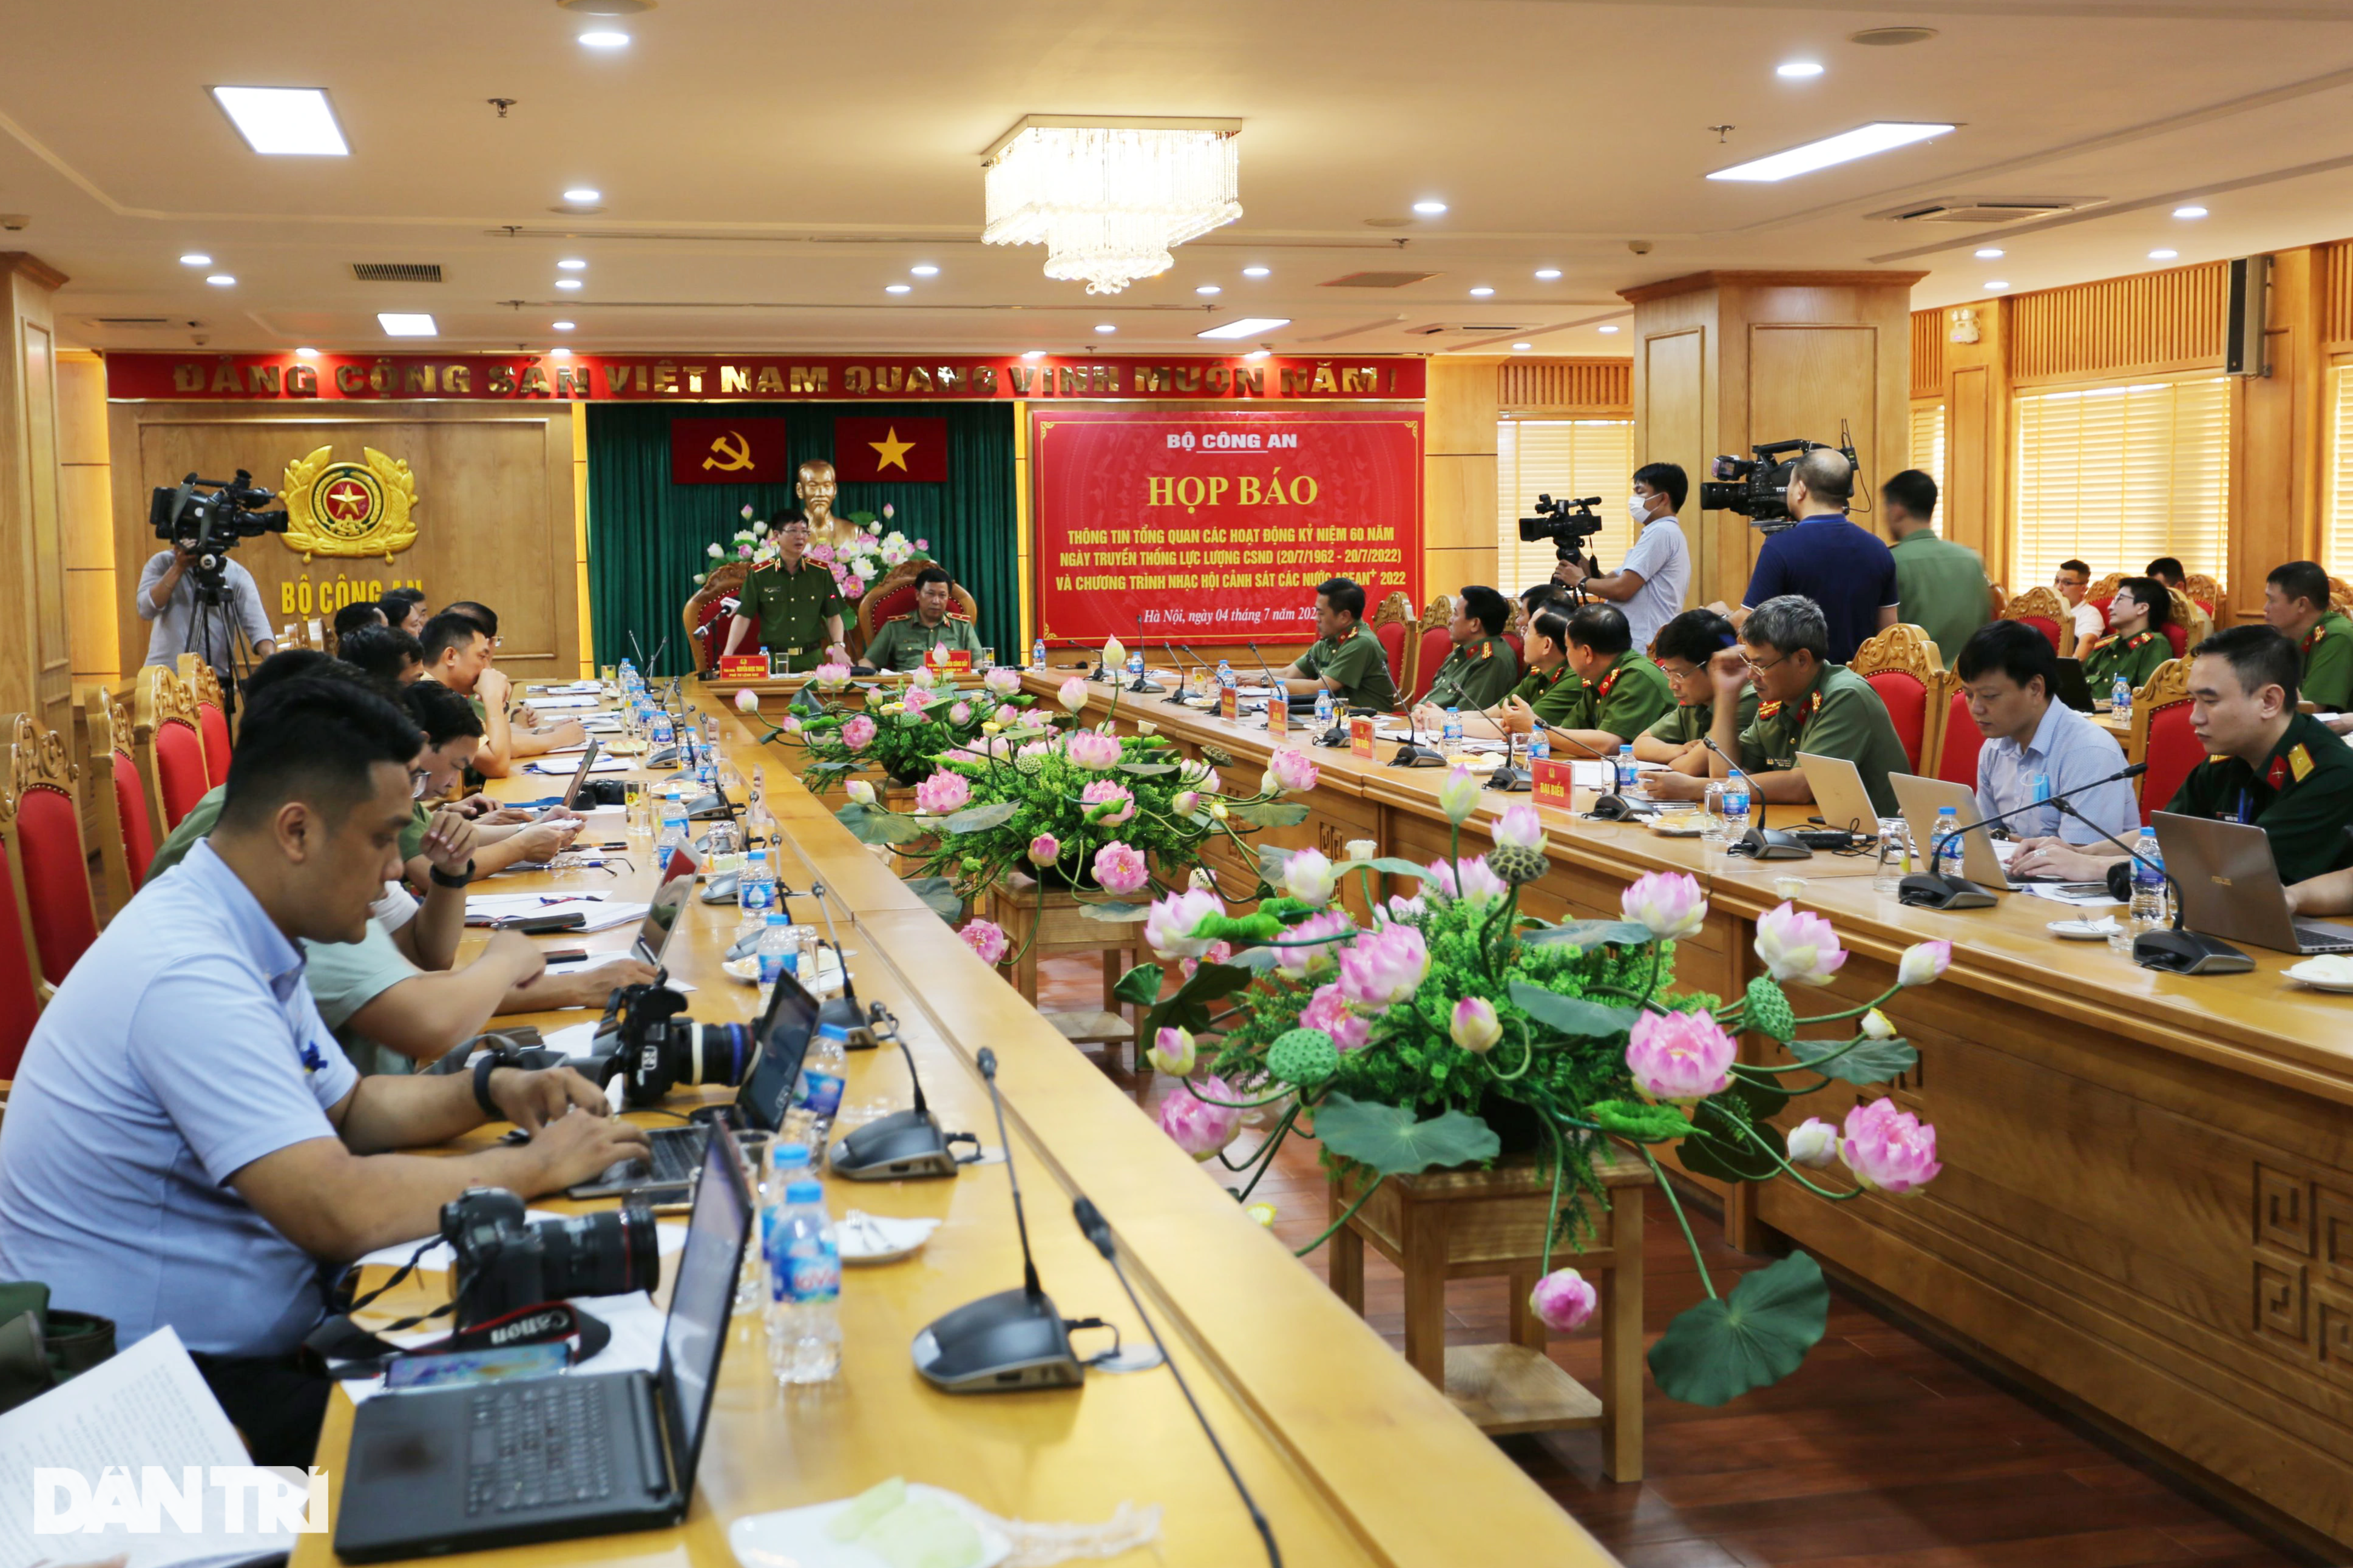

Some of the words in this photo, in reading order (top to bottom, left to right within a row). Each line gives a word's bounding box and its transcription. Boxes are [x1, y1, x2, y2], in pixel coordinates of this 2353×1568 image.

[173, 354, 317, 394] ĐẢNG
[335, 357, 471, 397] CỘNG
[488, 356, 589, 393] SẢN
[604, 359, 708, 397] VIỆT
[720, 366, 828, 393] NAM
[845, 366, 998, 394] QUANG
[1010, 367, 1119, 391] VINH
[1135, 361, 1264, 393] MUÔN
[1281, 362, 1377, 393] NĂM
[1166, 431, 1196, 451] BỘ
[1202, 431, 1261, 448] CÔNG
[1267, 434, 1297, 448] AN
[1147, 476, 1228, 514] HỌP
[1237, 467, 1318, 505] BÁO
[1068, 527, 1108, 544] THÔNG
[1111, 530, 1130, 544] TIN
[1134, 524, 1165, 544] TỔNG
[1168, 530, 1199, 545] QUAN
[1203, 526, 1227, 543] CÁC
[1230, 529, 1260, 546] HOẠT
[1262, 525, 1295, 546] ĐỘNG
[1298, 524, 1313, 542] KỶ
[1316, 525, 1347, 544] NIỆM
[1350, 527, 1364, 541] 60
[1367, 524, 1394, 541] NĂM
[1060, 550, 1091, 567] NGÀY
[1140, 547, 1177, 566] THỐNG
[1179, 550, 1200, 568] LỰC
[1204, 549, 1240, 568] LƯỢNG
[1243, 550, 1273, 564] CSND
[1277, 549, 1334, 565] (20/7/1962
[1345, 548, 1401, 563] 20/7/2022)
[1056, 573, 1072, 591] VÀ
[1075, 575, 1126, 590] CHƯƠNG
[1129, 572, 1166, 589] TRÌNH
[1168, 575, 1199, 592] NHẠC
[1201, 572, 1219, 591] HỘI
[1222, 569, 1252, 589] CẢNH
[1254, 570, 1276, 587] SÁT
[1278, 570, 1299, 587] CÁC
[1380, 571, 1406, 586] 2022
[281, 574, 312, 621] BỘ
[319, 573, 382, 614] CÔNG
[1144, 609, 1160, 623] Hà
[1163, 609, 1185, 625] Nội,
[1188, 610, 1213, 625] ngày
[1215, 609, 1228, 621] 04
[1230, 607, 1261, 623] tháng
[1264, 608, 1270, 620] 7
[1273, 609, 1295, 620] năm
[1298, 607, 1318, 620] 202
[1540, 782, 1550, 796] ĐẠI
[1551, 781, 1564, 798] BIỂU
[490, 1310, 569, 1345] Canon
